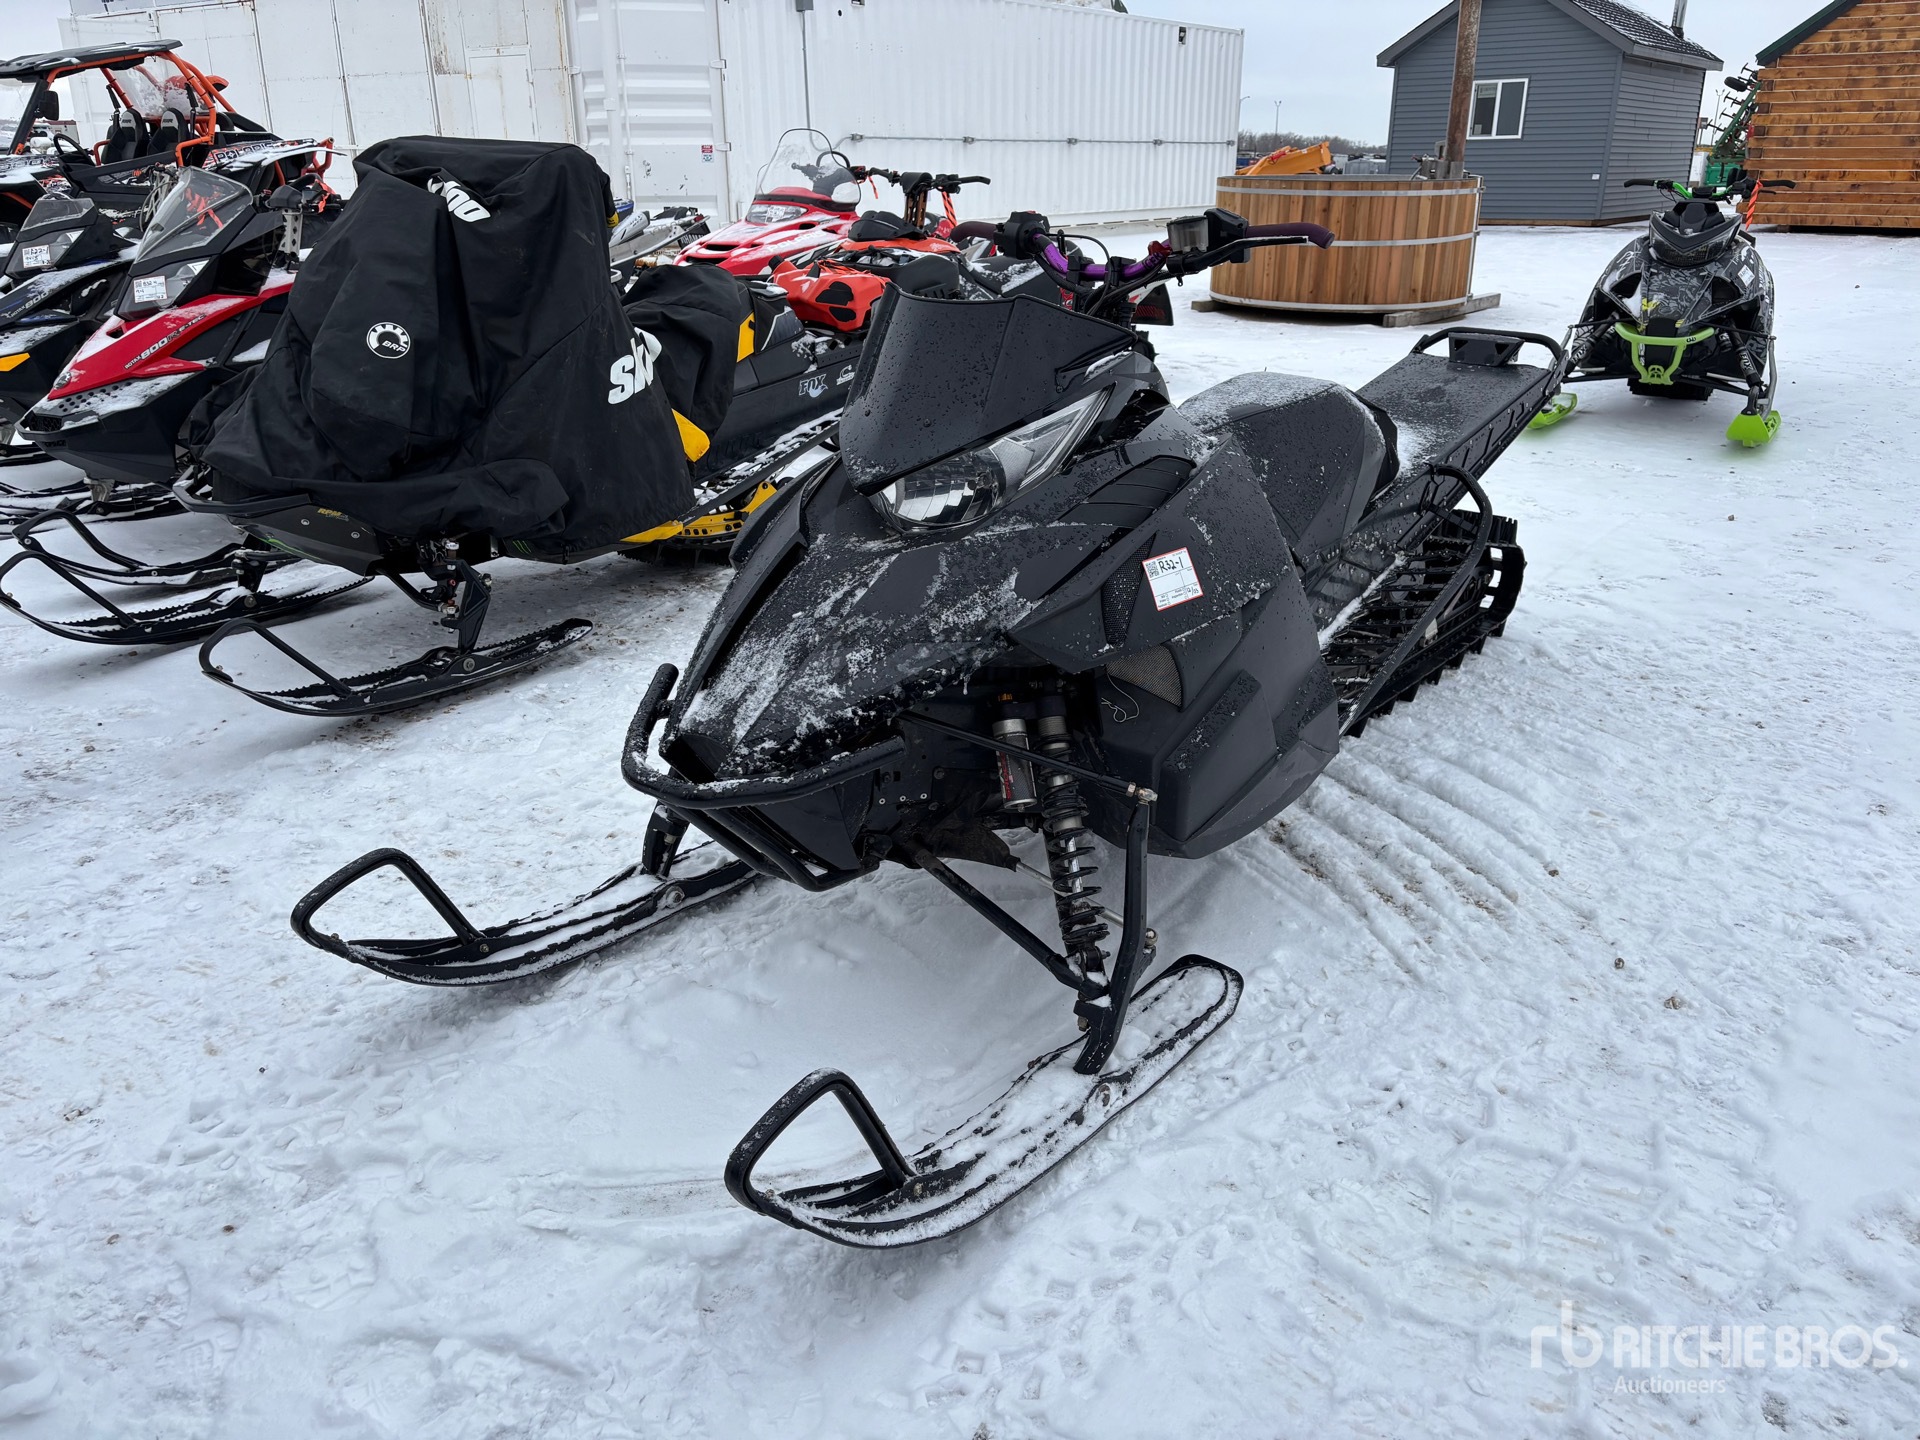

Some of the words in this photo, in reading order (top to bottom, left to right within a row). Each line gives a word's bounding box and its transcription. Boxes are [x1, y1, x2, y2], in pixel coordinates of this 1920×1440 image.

[381, 340, 406, 352] BRP
[124, 355, 142, 369] ROTAX
[799, 374, 828, 396] FOX
[1158, 556, 1184, 573] R32-1
